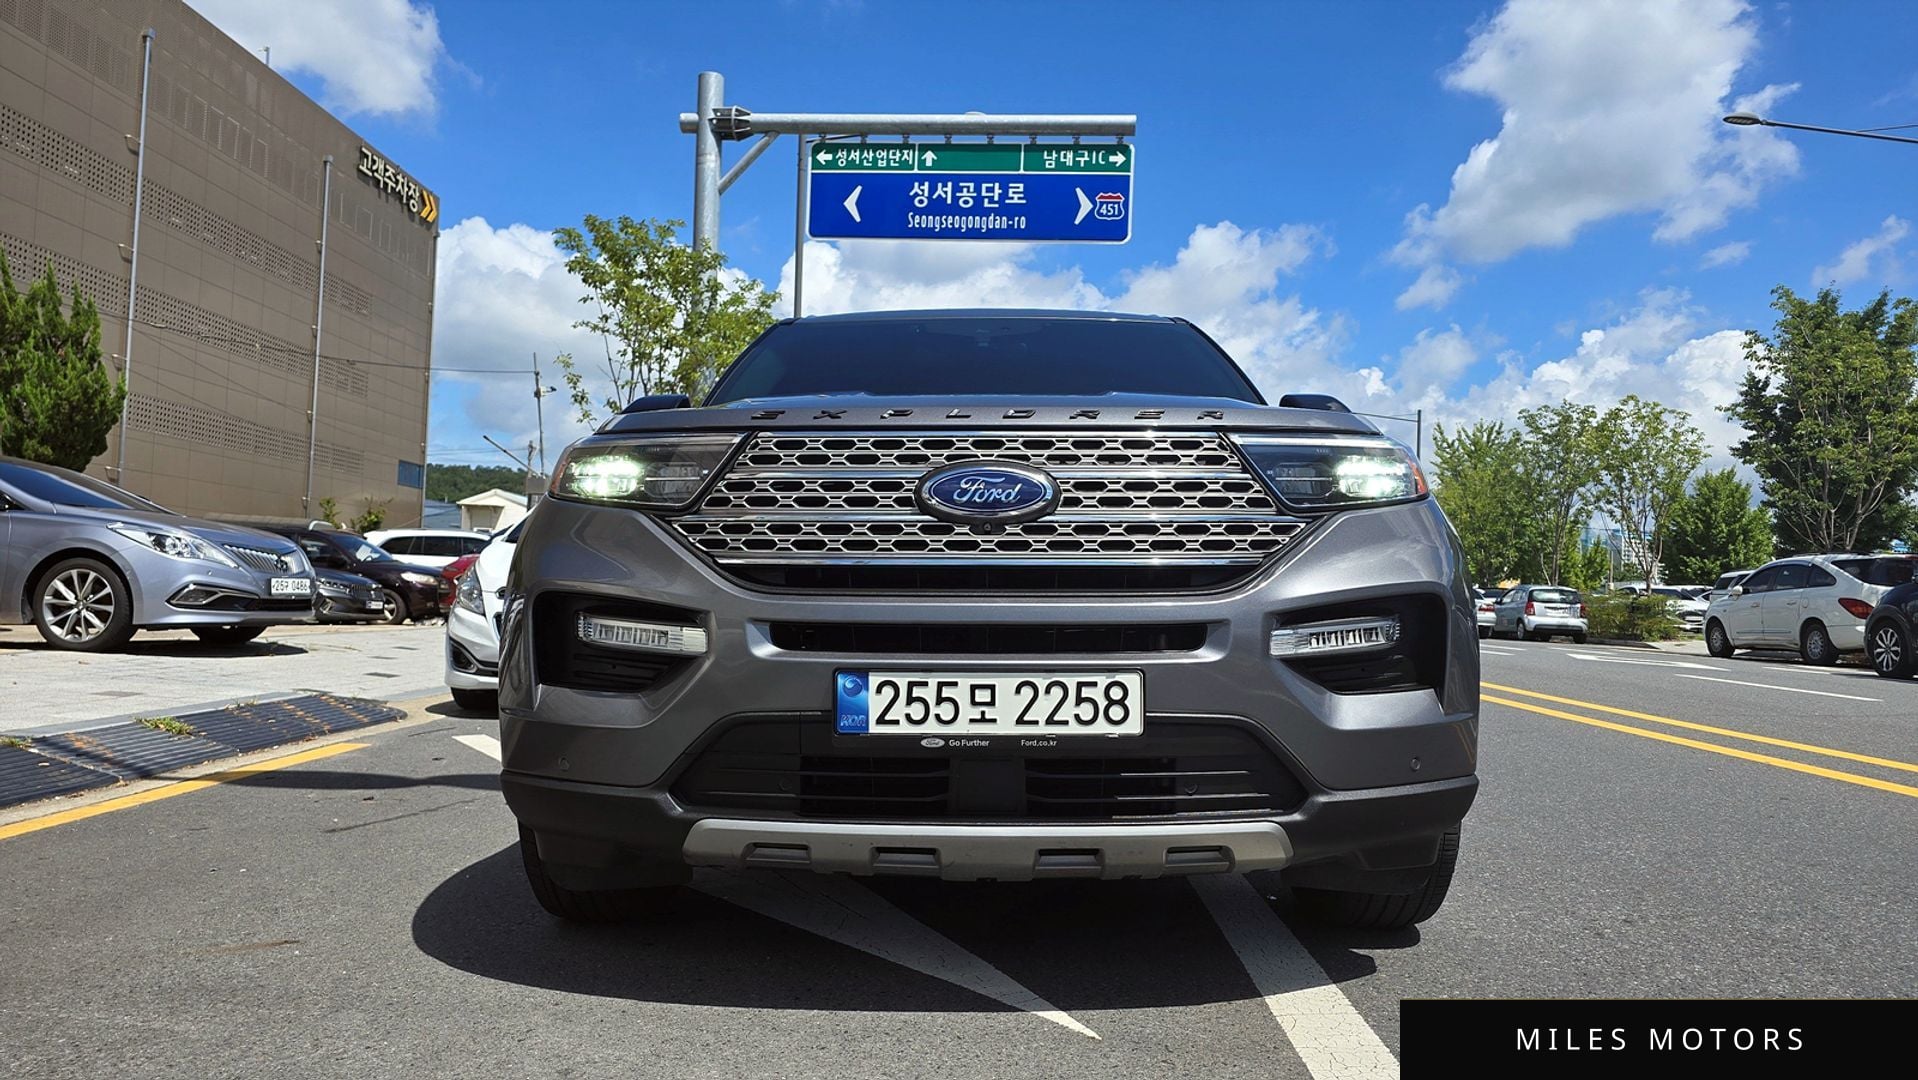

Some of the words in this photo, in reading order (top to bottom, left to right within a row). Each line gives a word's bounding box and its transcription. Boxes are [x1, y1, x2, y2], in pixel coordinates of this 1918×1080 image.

[835, 149, 914, 168] 성서산업단지
[359, 147, 419, 212] 고객주차장
[908, 181, 1027, 208] 성서공단로
[1099, 203, 1119, 216] 451
[908, 212, 1027, 233] Seongseogongdan-ro
[750, 408, 1225, 420] EXPLORER
[952, 473, 1022, 505] Ford
[875, 679, 998, 726] 255모
[1014, 679, 1131, 726] 2258
[949, 739, 960, 747] Go
[961, 739, 990, 747] Further
[1021, 739, 1057, 747] Ford.co.kr
